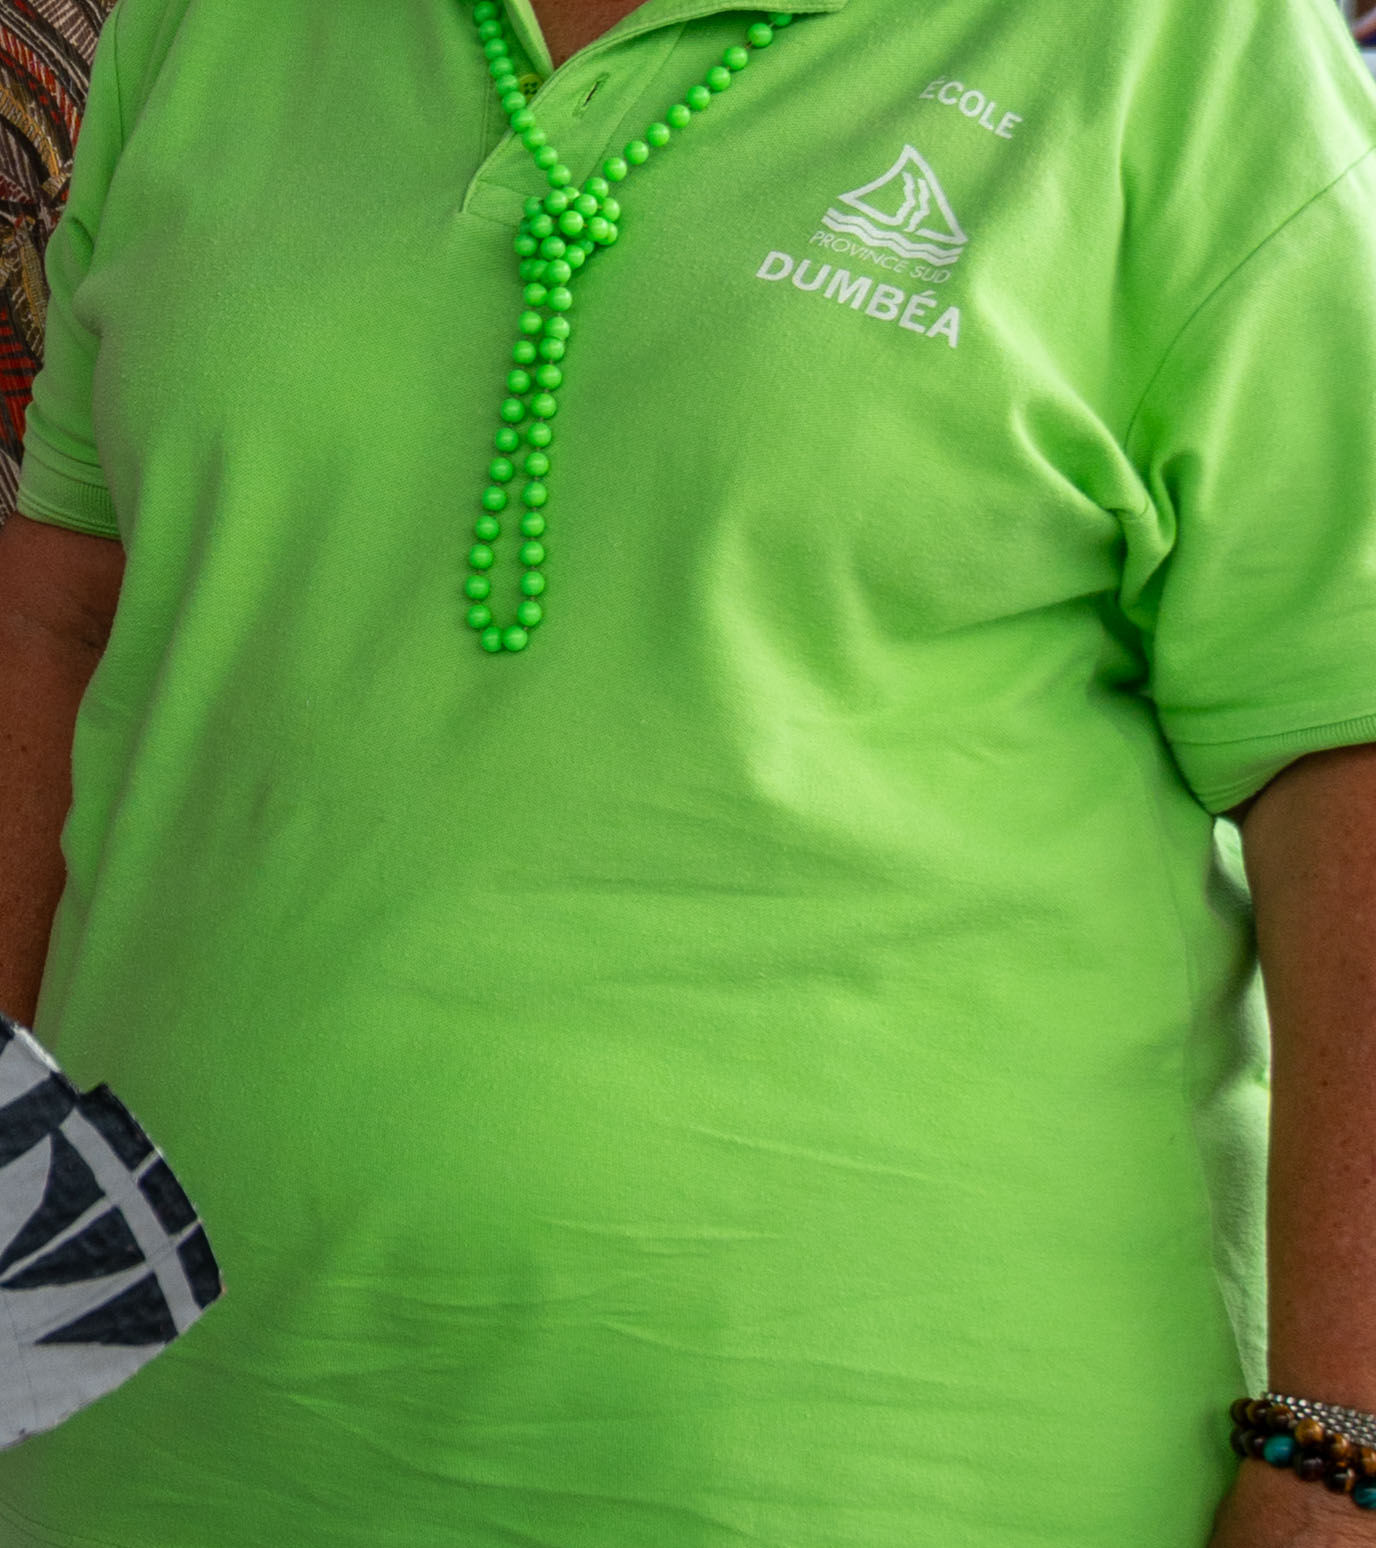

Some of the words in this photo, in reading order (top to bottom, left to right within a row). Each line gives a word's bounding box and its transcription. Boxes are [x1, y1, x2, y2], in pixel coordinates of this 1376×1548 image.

[919, 78, 1022, 139] ÉCOLE
[809, 230, 910, 273] PROVINCE
[910, 265, 951, 284] SUD
[756, 250, 961, 348] DUMBÉA
